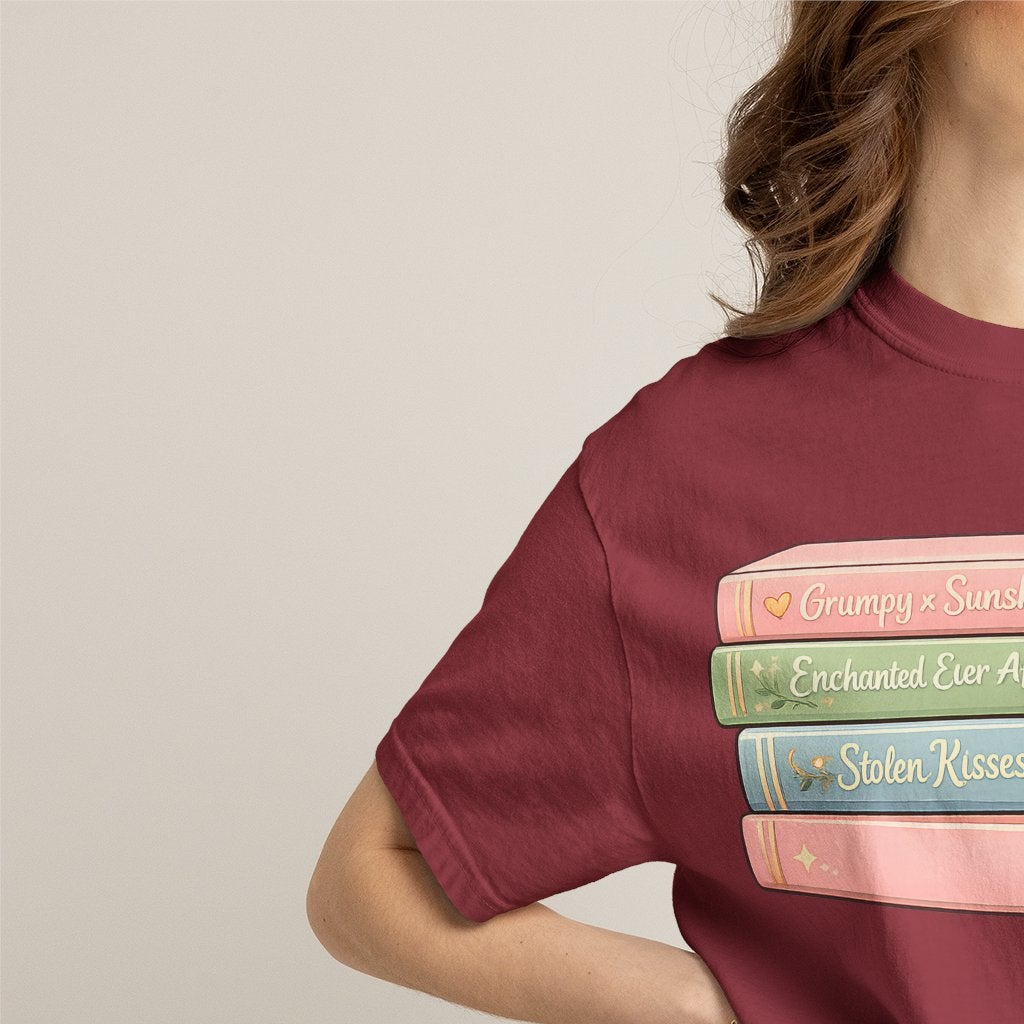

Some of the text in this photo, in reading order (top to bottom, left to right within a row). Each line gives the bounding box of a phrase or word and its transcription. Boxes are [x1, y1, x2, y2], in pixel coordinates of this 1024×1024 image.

[800, 582, 912, 628] Grumpy
[789, 655, 927, 698] Enchanted
[837, 742, 931, 791] Stolen
